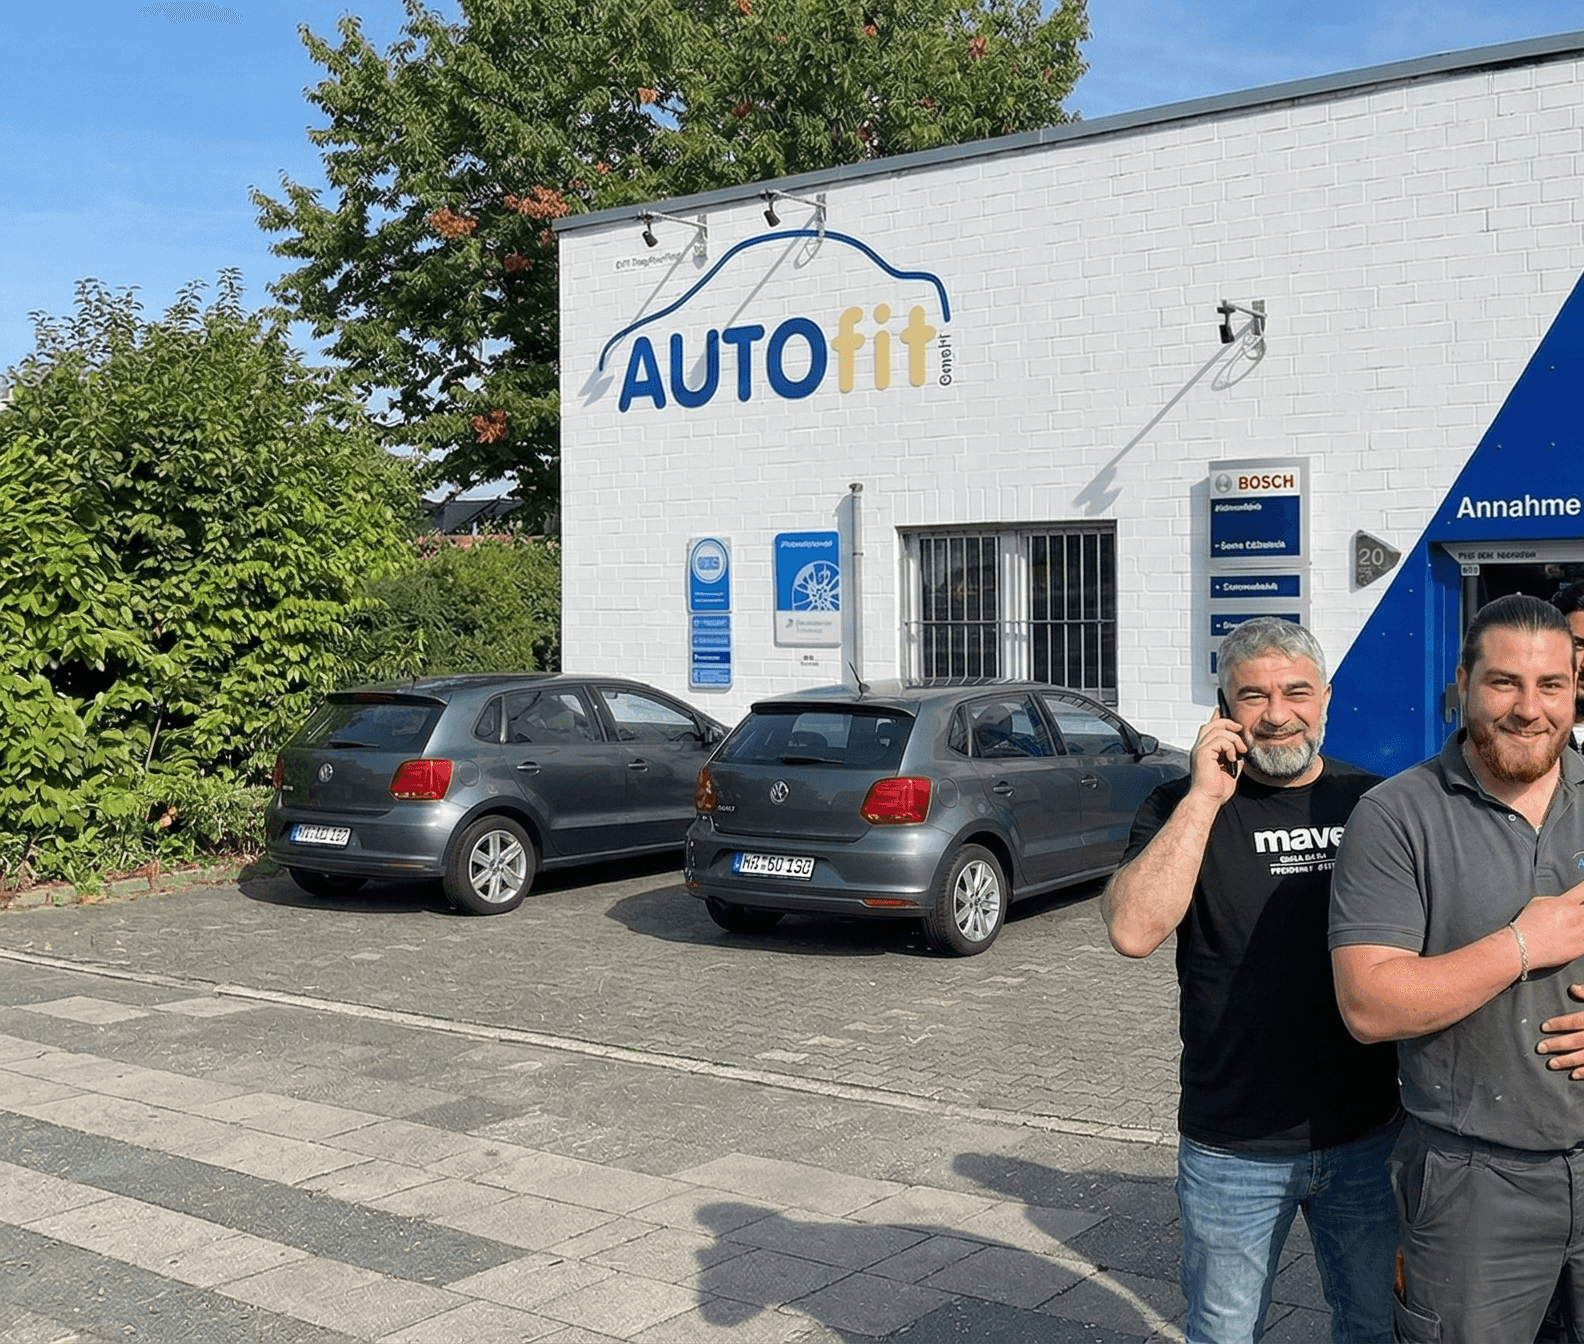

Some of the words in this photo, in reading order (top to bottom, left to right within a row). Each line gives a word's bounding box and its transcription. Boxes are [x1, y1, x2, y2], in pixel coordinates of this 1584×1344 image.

[618, 302, 937, 413] AUTOfit
[1238, 474, 1294, 490] BOSCH
[1456, 494, 1582, 519] Annahme
[1358, 547, 1385, 566] 20
